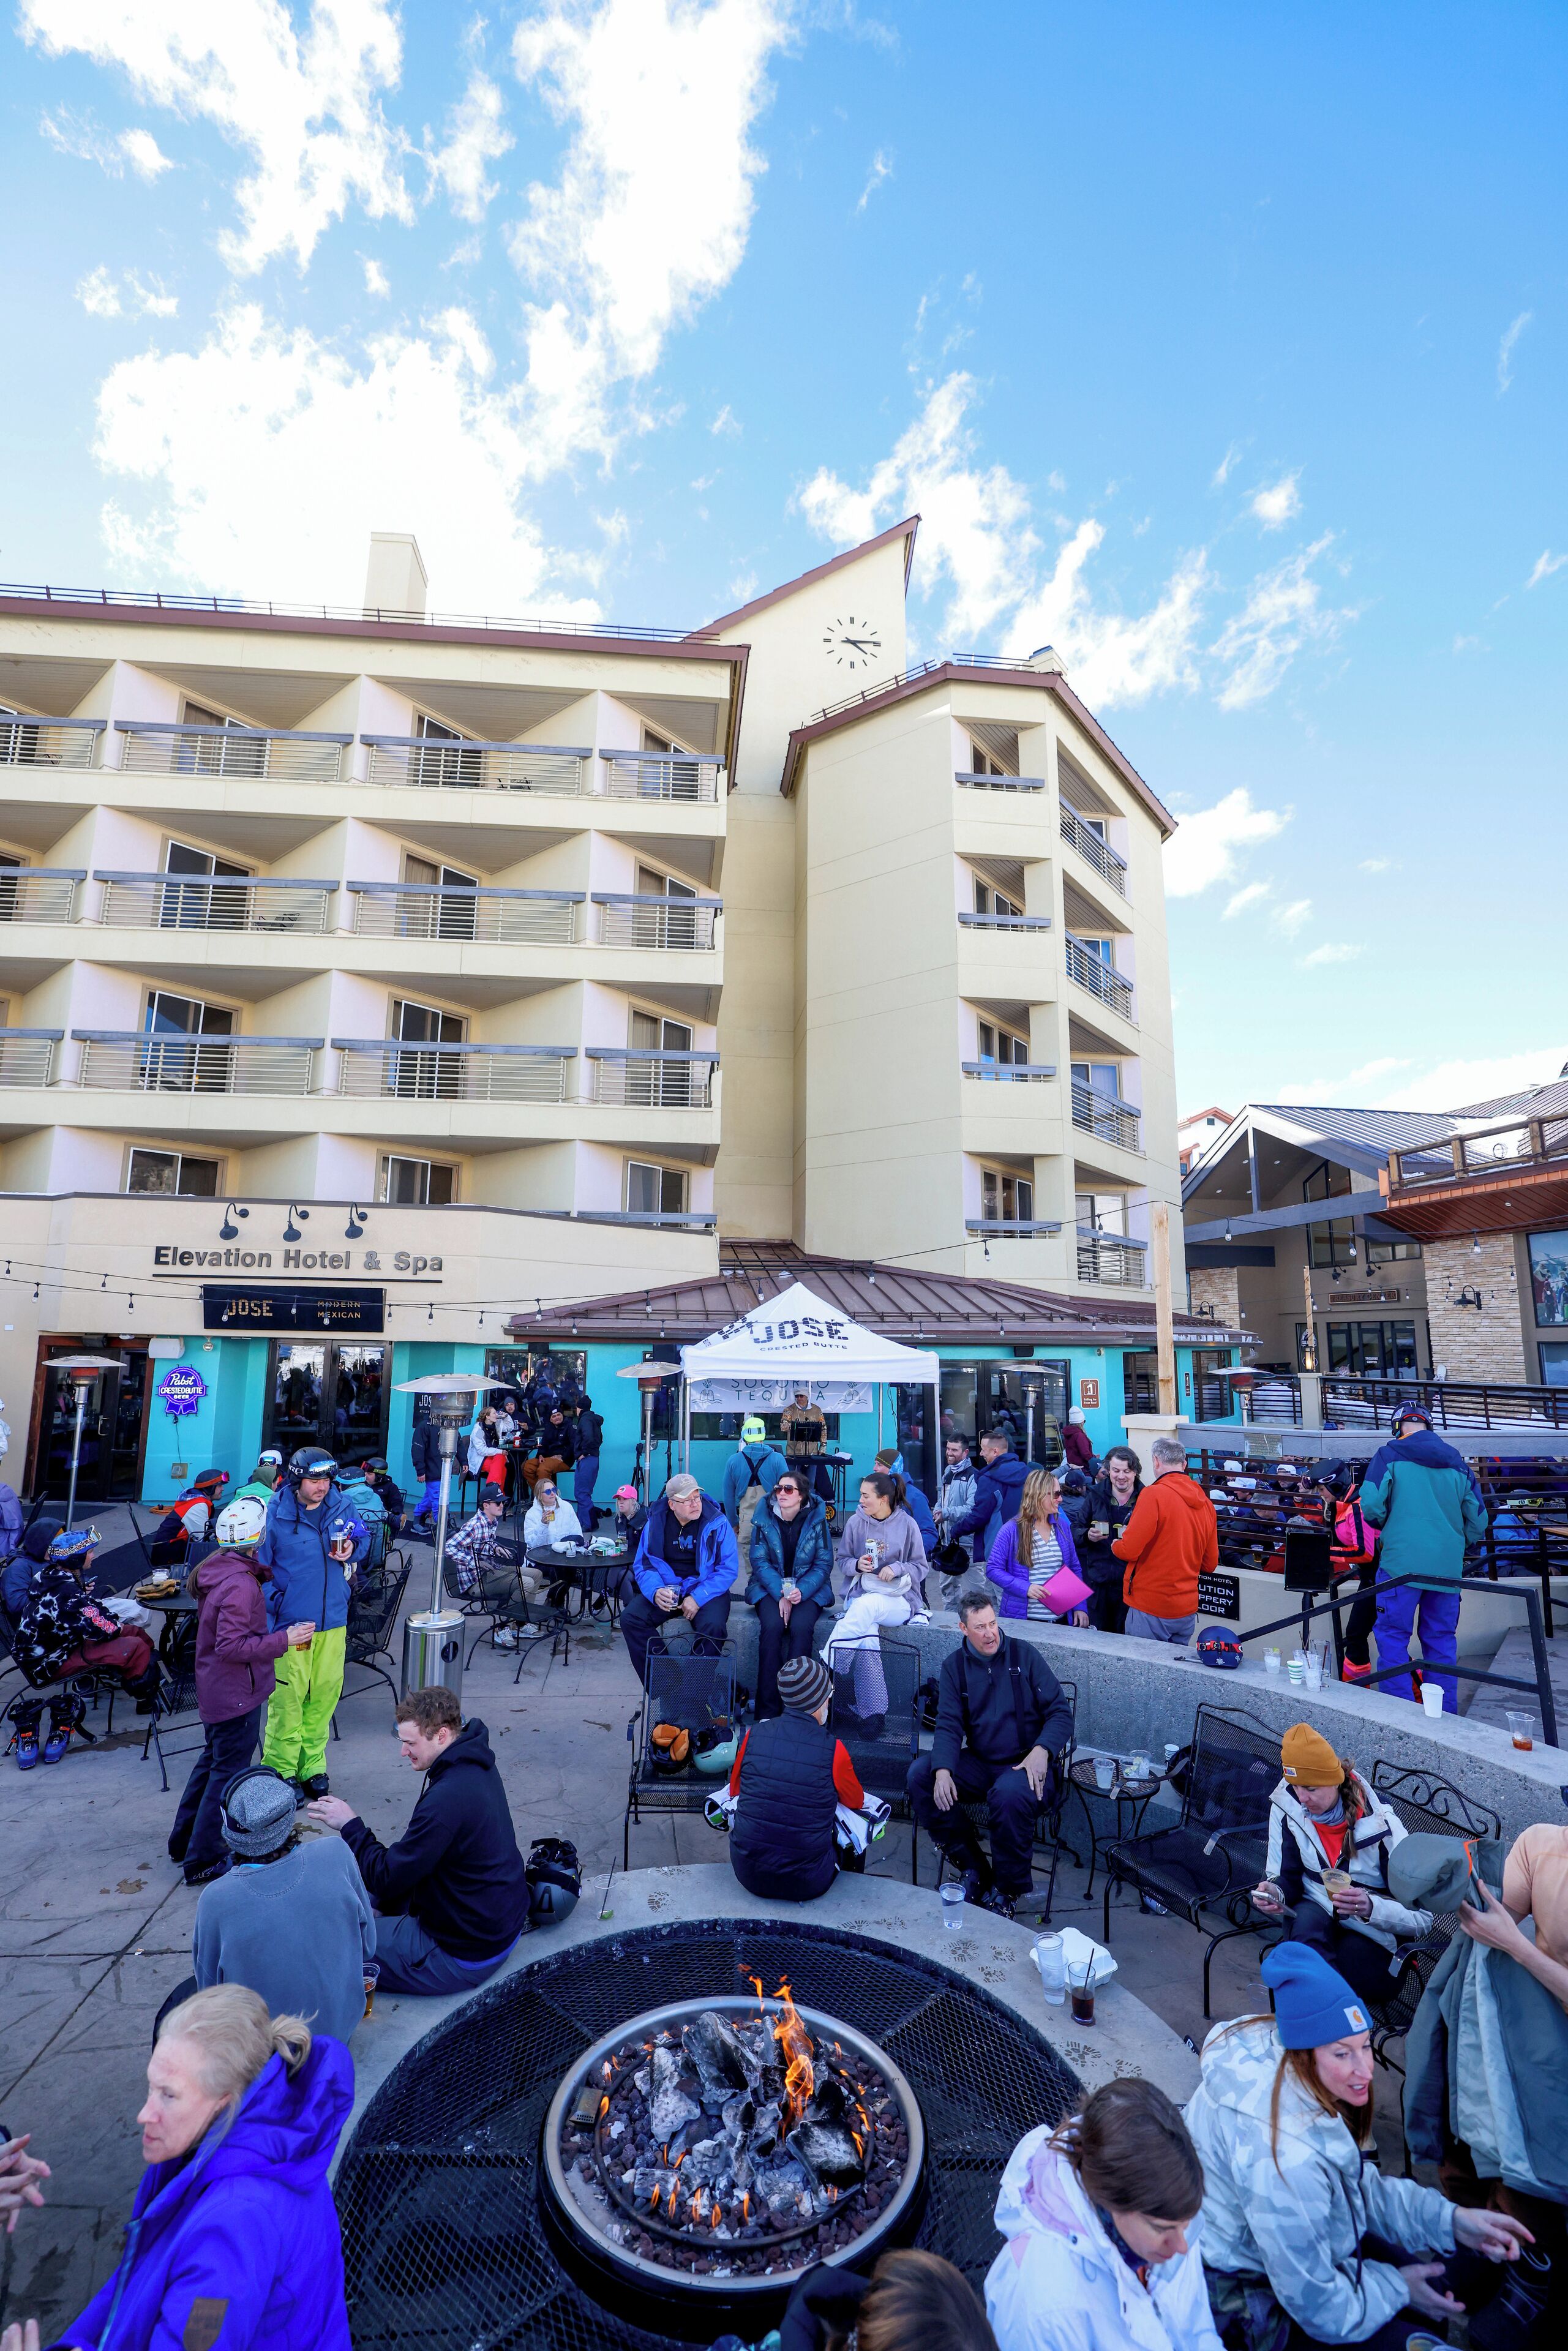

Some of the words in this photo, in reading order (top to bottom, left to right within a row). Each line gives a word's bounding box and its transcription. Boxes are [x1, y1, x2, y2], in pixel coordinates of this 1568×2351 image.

[154, 1246, 272, 1267] Elevation
[283, 1249, 351, 1269] Hotel
[364, 1250, 381, 1270] &
[394, 1251, 443, 1275] Spa
[1367, 1291, 1396, 1300] CENER
[228, 1299, 272, 1317] JOSE
[760, 1342, 809, 1351] CRESTED
[170, 1373, 195, 1385] Pabst
[419, 1394, 431, 1408] JOS
[735, 1390, 825, 1402] TEQUA
[1198, 1584, 1234, 1597] UTION
[1198, 1594, 1233, 1606] PPERY
